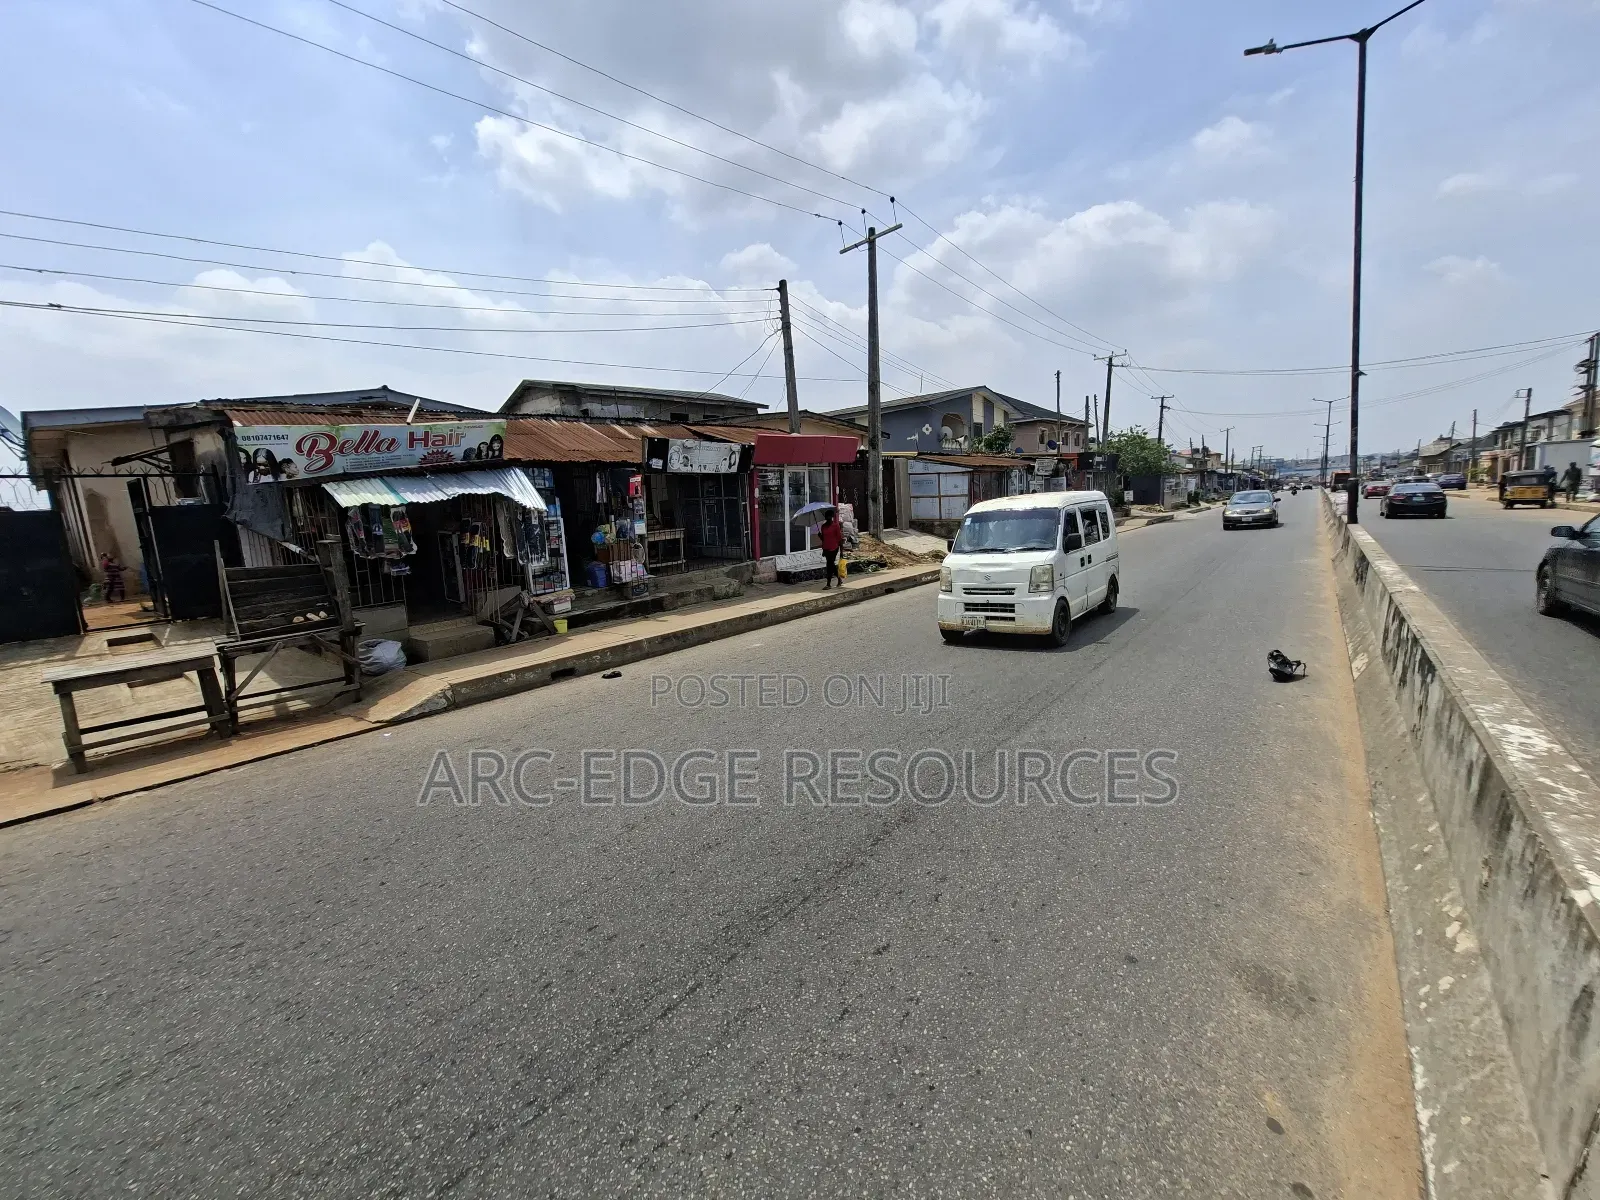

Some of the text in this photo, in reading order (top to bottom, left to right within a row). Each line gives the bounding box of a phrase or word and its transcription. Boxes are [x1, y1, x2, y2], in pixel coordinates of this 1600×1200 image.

[241, 433, 289, 442] 08107471647
[295, 430, 401, 474] Bella
[408, 429, 466, 449] Hair
